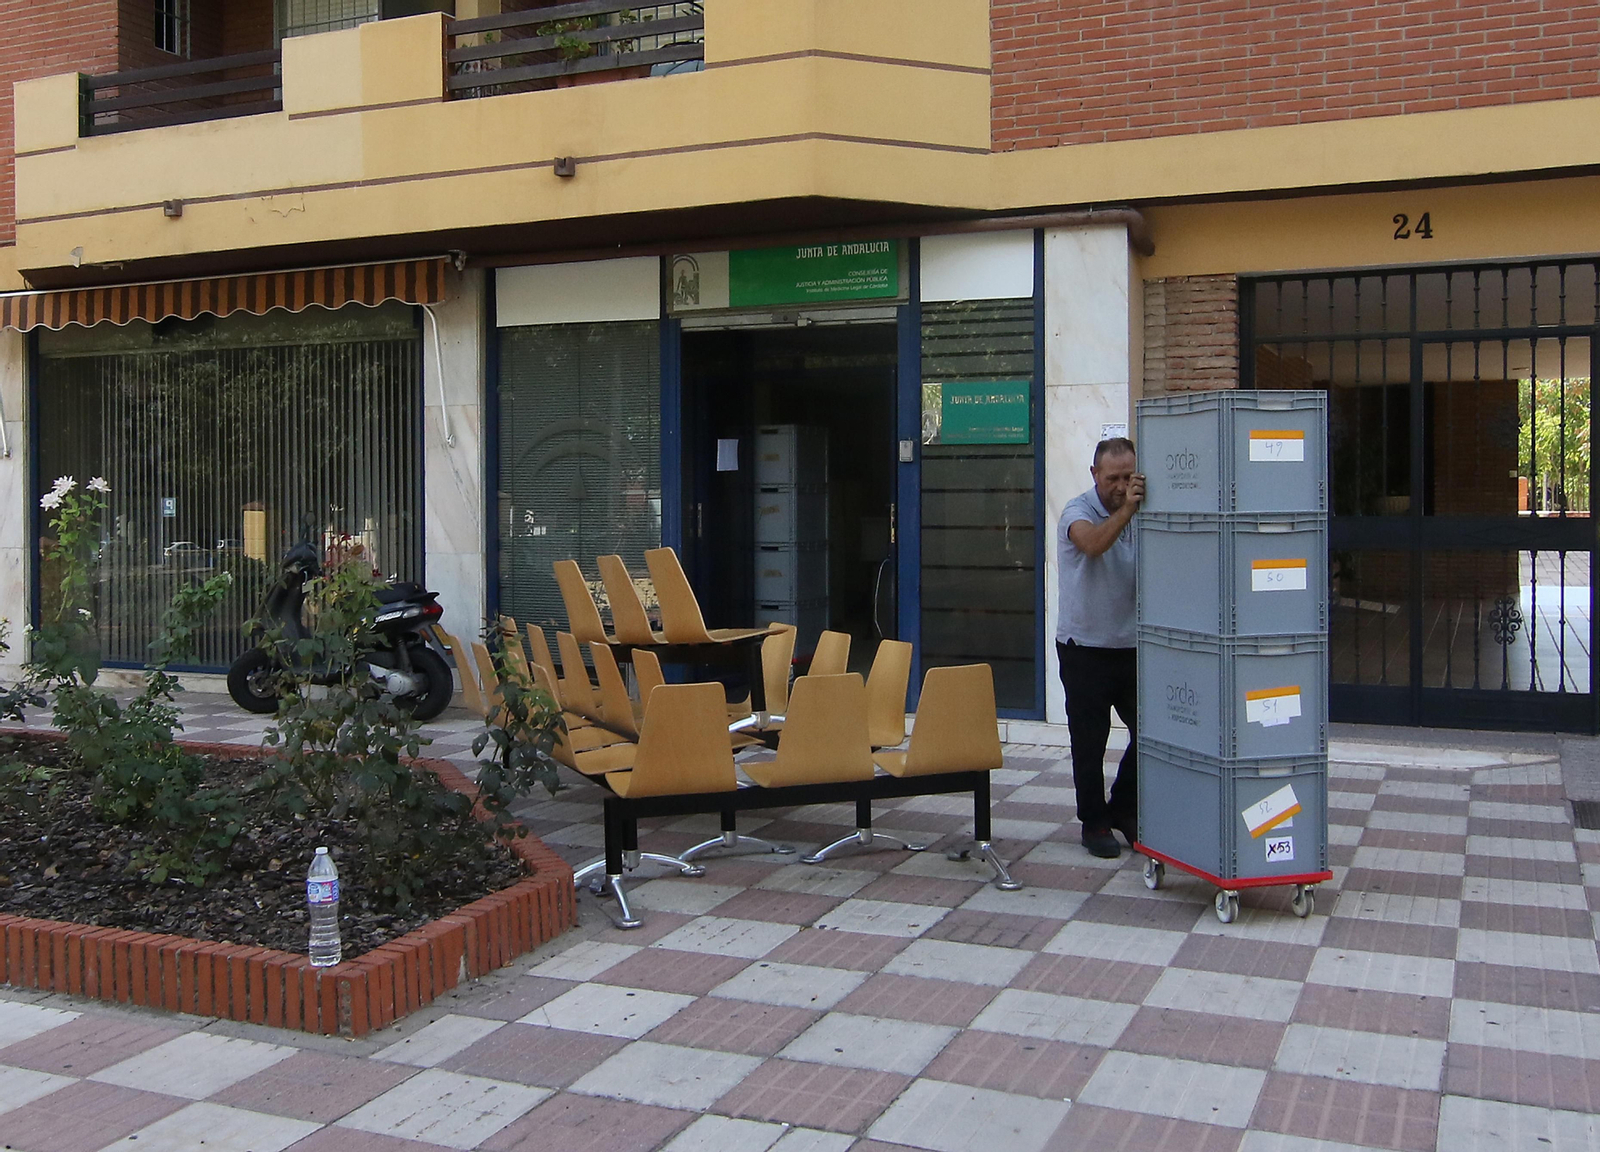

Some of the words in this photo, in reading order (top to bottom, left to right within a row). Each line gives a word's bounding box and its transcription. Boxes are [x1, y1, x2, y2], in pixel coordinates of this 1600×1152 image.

[1393, 212, 1433, 240] 24
[796, 246, 823, 259] JUNTA
[827, 245, 838, 257] DE
[1265, 441, 1283, 457] 49
[1266, 571, 1284, 582] 50
[1263, 699, 1278, 713] 51
[1259, 800, 1273, 815] 52
